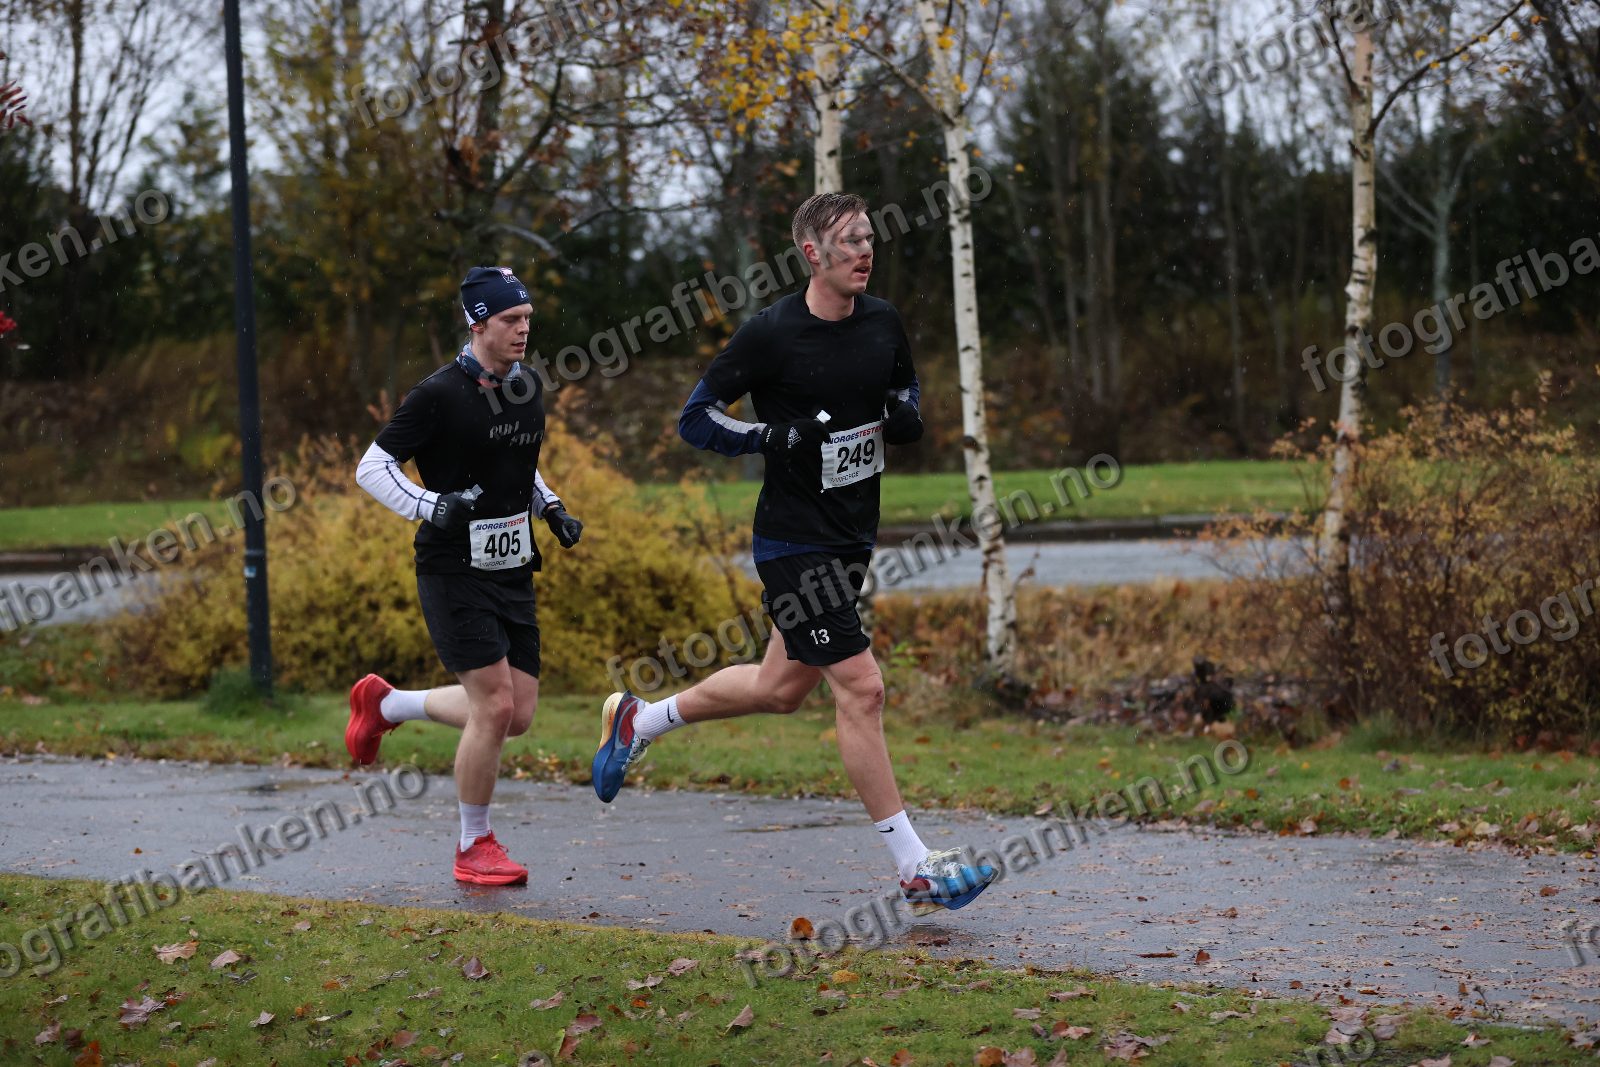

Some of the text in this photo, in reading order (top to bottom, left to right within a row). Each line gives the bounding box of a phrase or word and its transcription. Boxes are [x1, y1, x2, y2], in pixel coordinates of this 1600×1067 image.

[836, 438, 876, 475] 249
[484, 529, 521, 559] 405
[809, 628, 831, 646] 13
